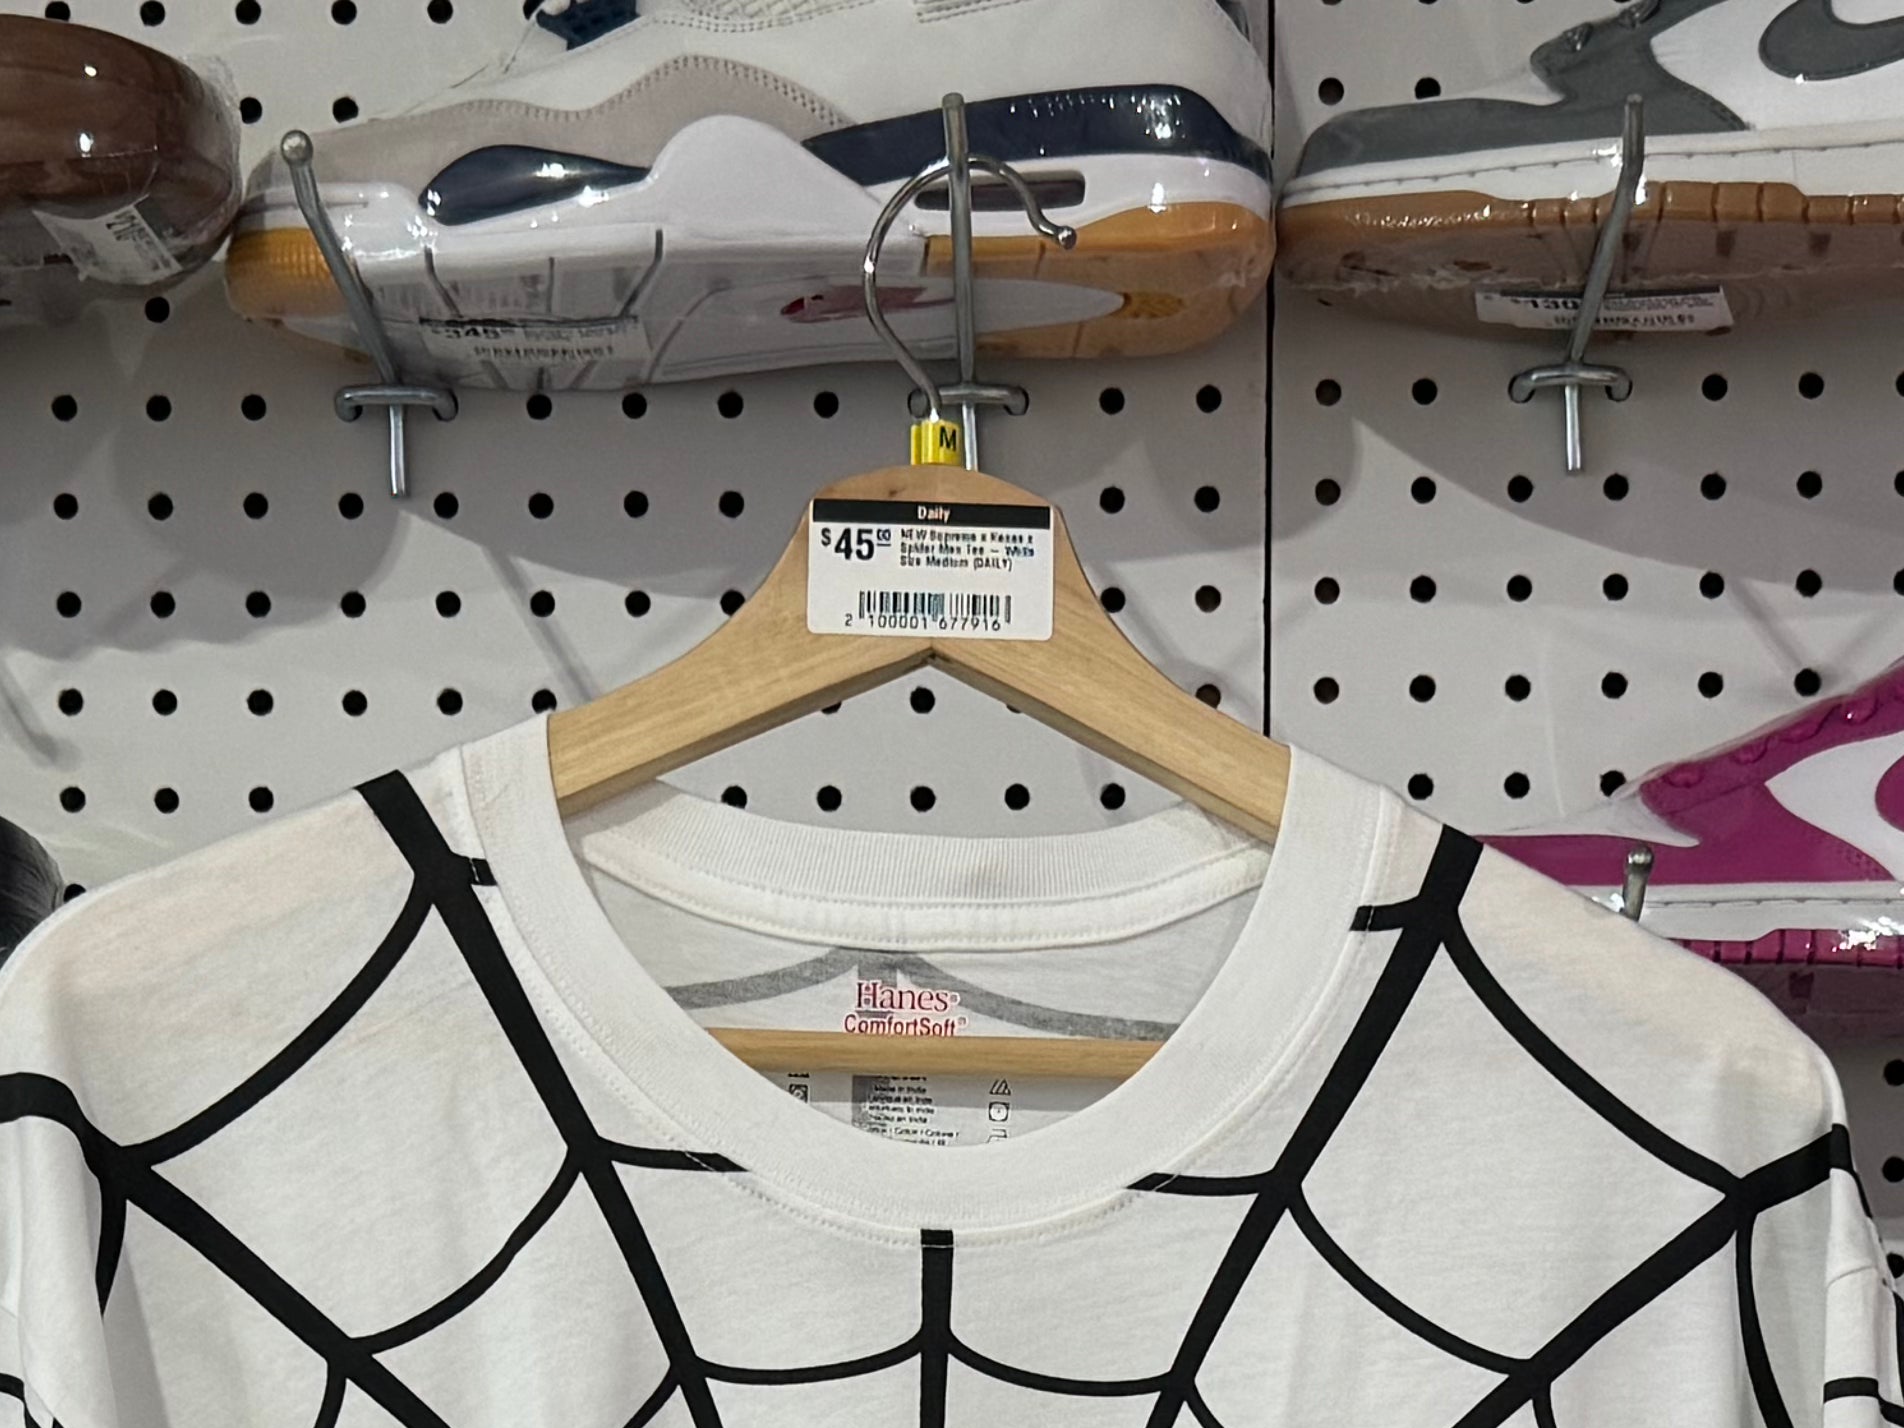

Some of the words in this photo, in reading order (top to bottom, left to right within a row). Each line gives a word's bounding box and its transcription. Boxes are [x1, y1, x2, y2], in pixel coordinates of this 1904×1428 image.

[938, 427, 958, 451] M
[916, 505, 952, 524] Daily
[900, 528, 927, 541] NEW
[899, 555, 922, 567] Size
[925, 556, 969, 568] Medium
[973, 556, 1013, 572] (DAILY)
[844, 613, 853, 627] 2
[869, 613, 928, 630] 100001
[938, 614, 1002, 632] 677916
